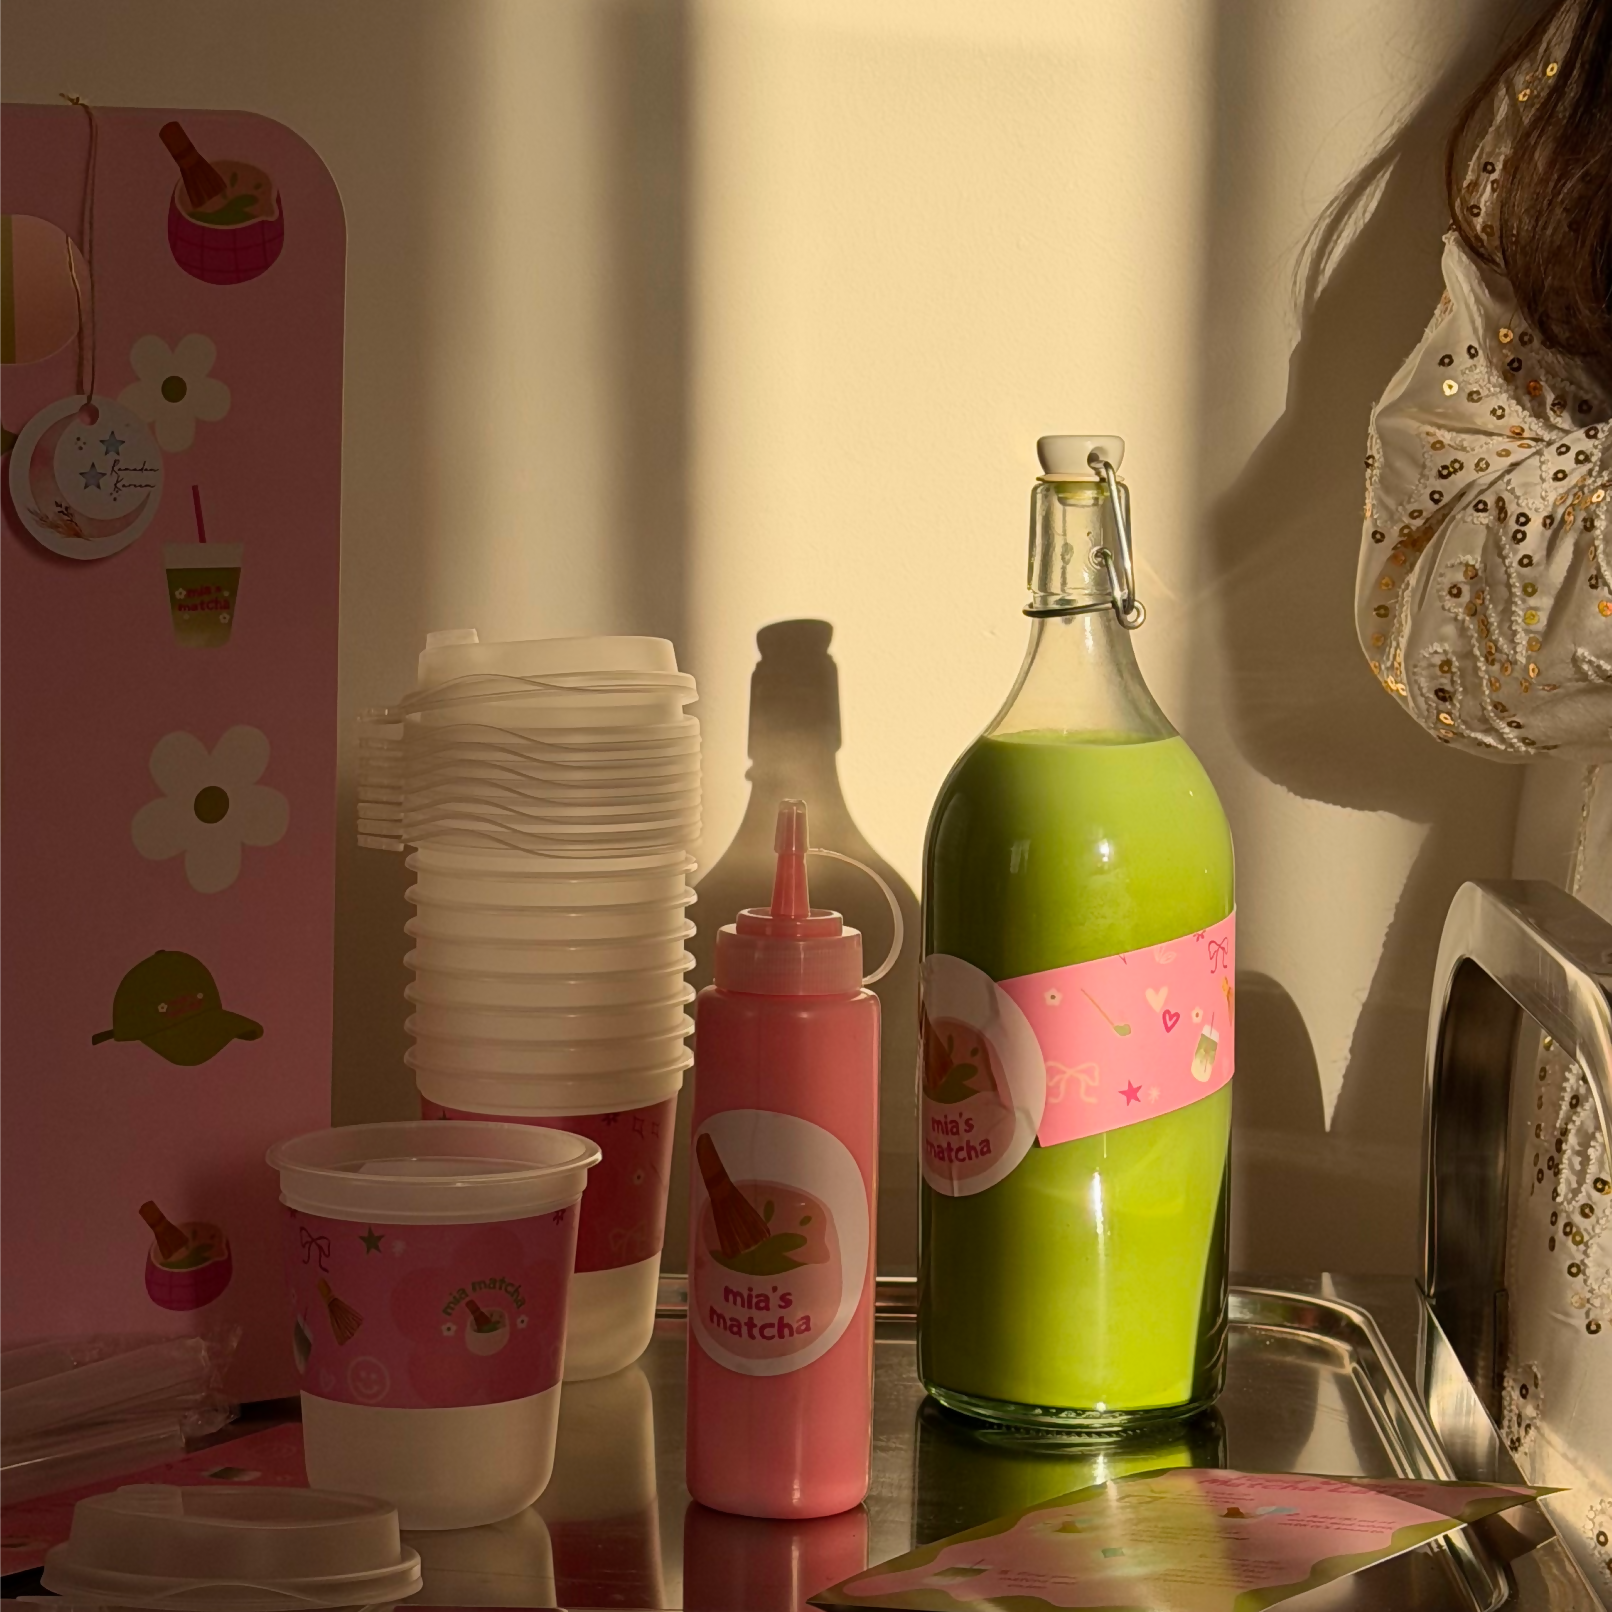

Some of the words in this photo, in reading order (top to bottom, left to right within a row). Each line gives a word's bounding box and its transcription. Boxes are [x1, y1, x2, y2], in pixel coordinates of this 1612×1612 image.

[110, 459, 159, 475] Ramadan
[178, 597, 230, 612] matcha
[931, 1112, 975, 1136] mia's
[442, 1287, 469, 1316] mia
[471, 1276, 526, 1310] matcha
[723, 1285, 793, 1312] mia's
[709, 1305, 811, 1340] matcha
